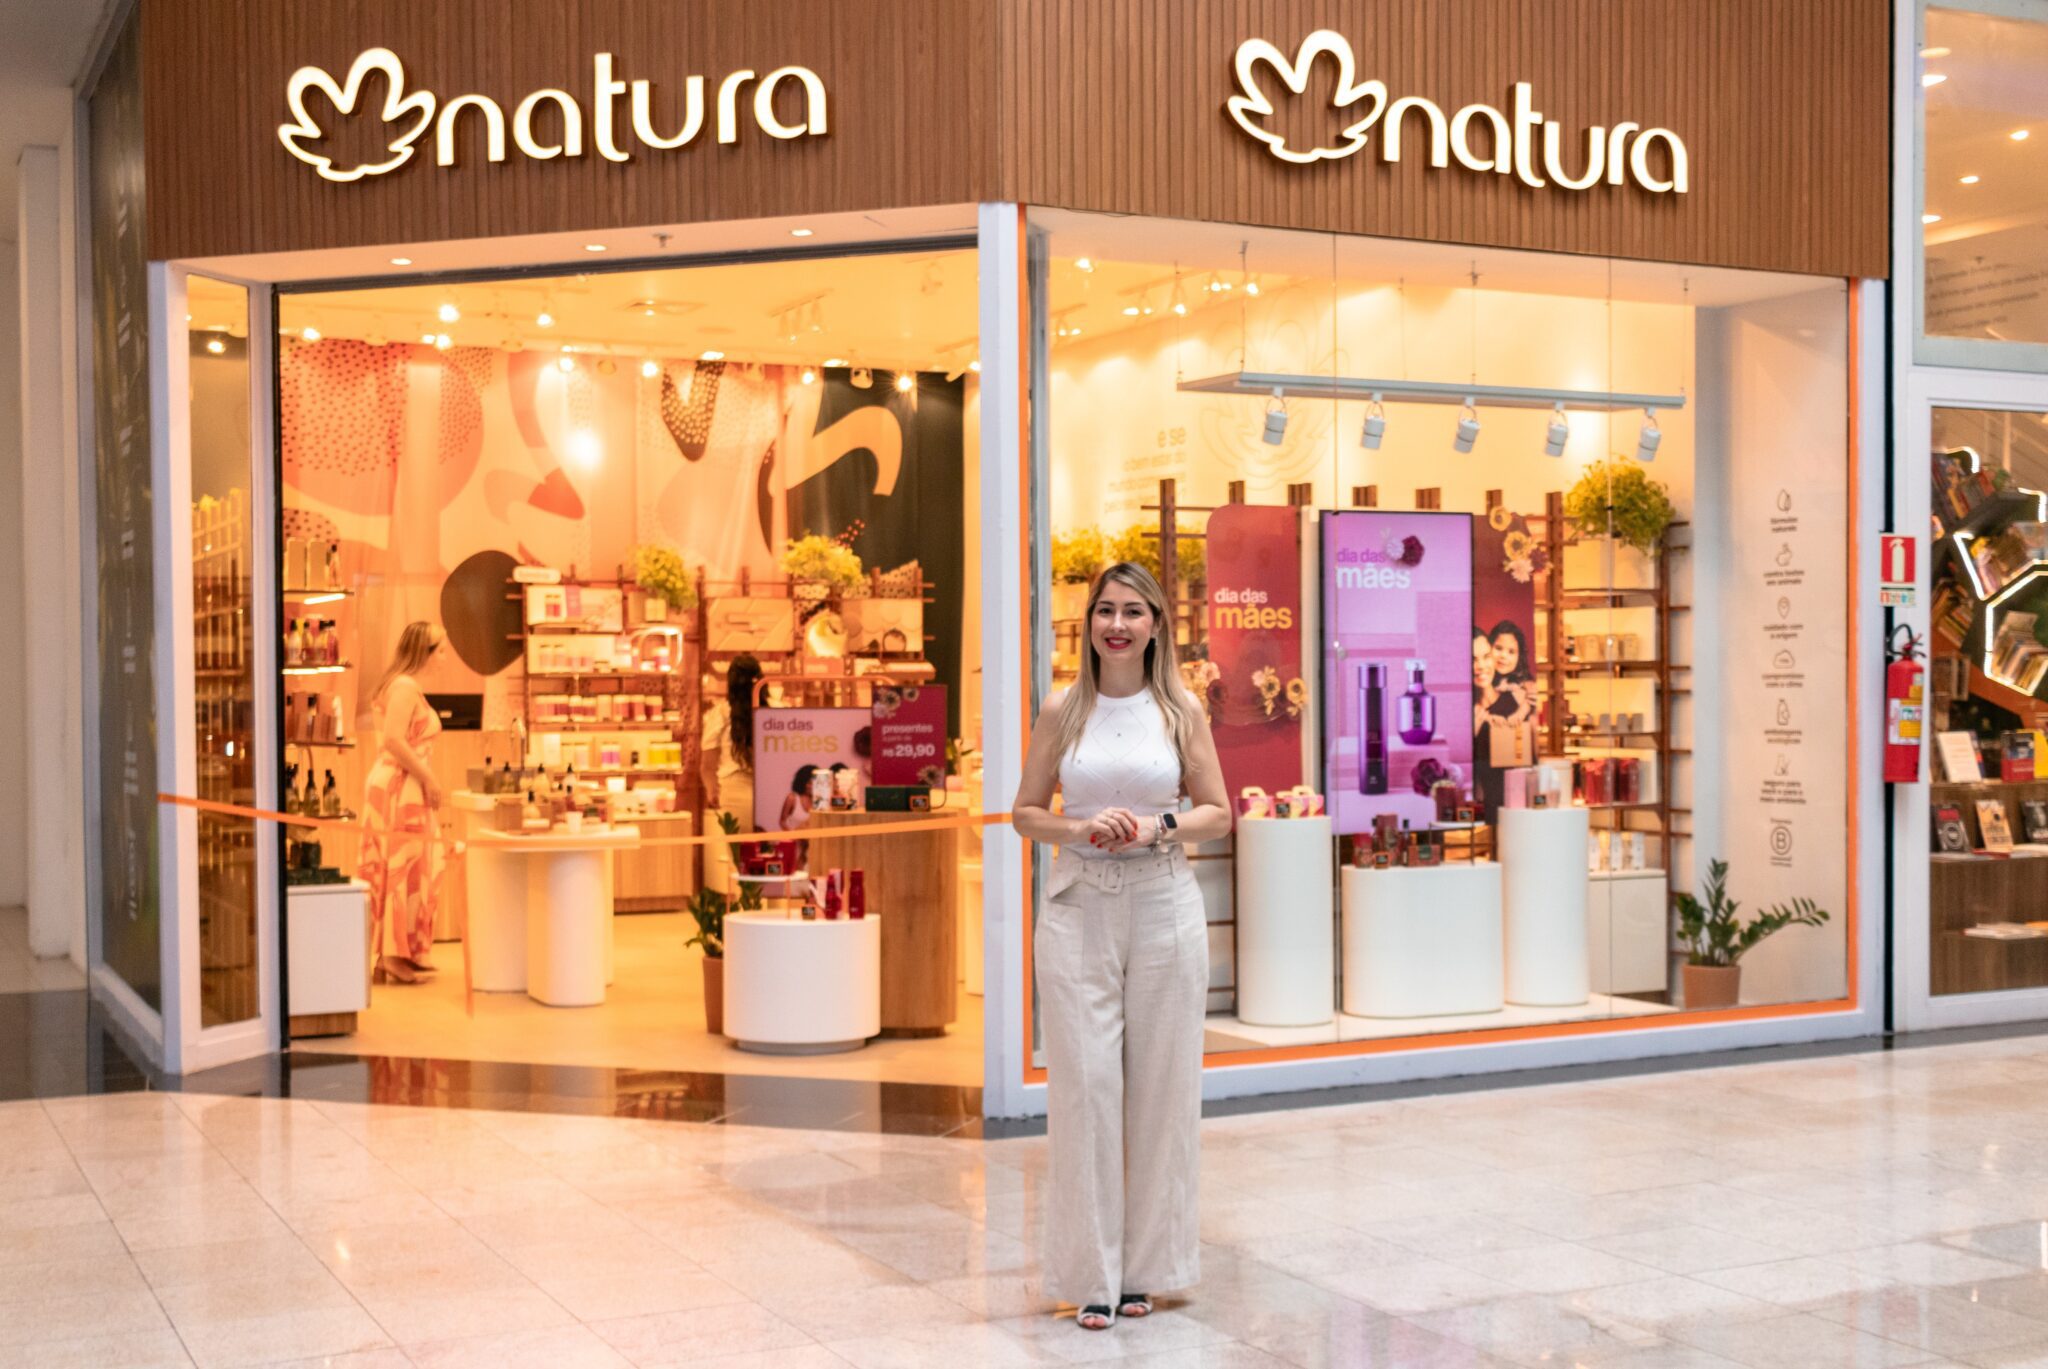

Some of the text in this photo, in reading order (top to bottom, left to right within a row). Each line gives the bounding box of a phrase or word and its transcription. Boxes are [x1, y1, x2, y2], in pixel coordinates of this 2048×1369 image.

[437, 52, 828, 167] natura
[1383, 81, 1688, 194] natura
[1337, 547, 1387, 563] dia das
[1336, 562, 1412, 590] mães
[1214, 587, 1269, 604] dia das
[1215, 602, 1293, 630] mães
[762, 718, 814, 731] dia das
[895, 743, 936, 760] 29,90
